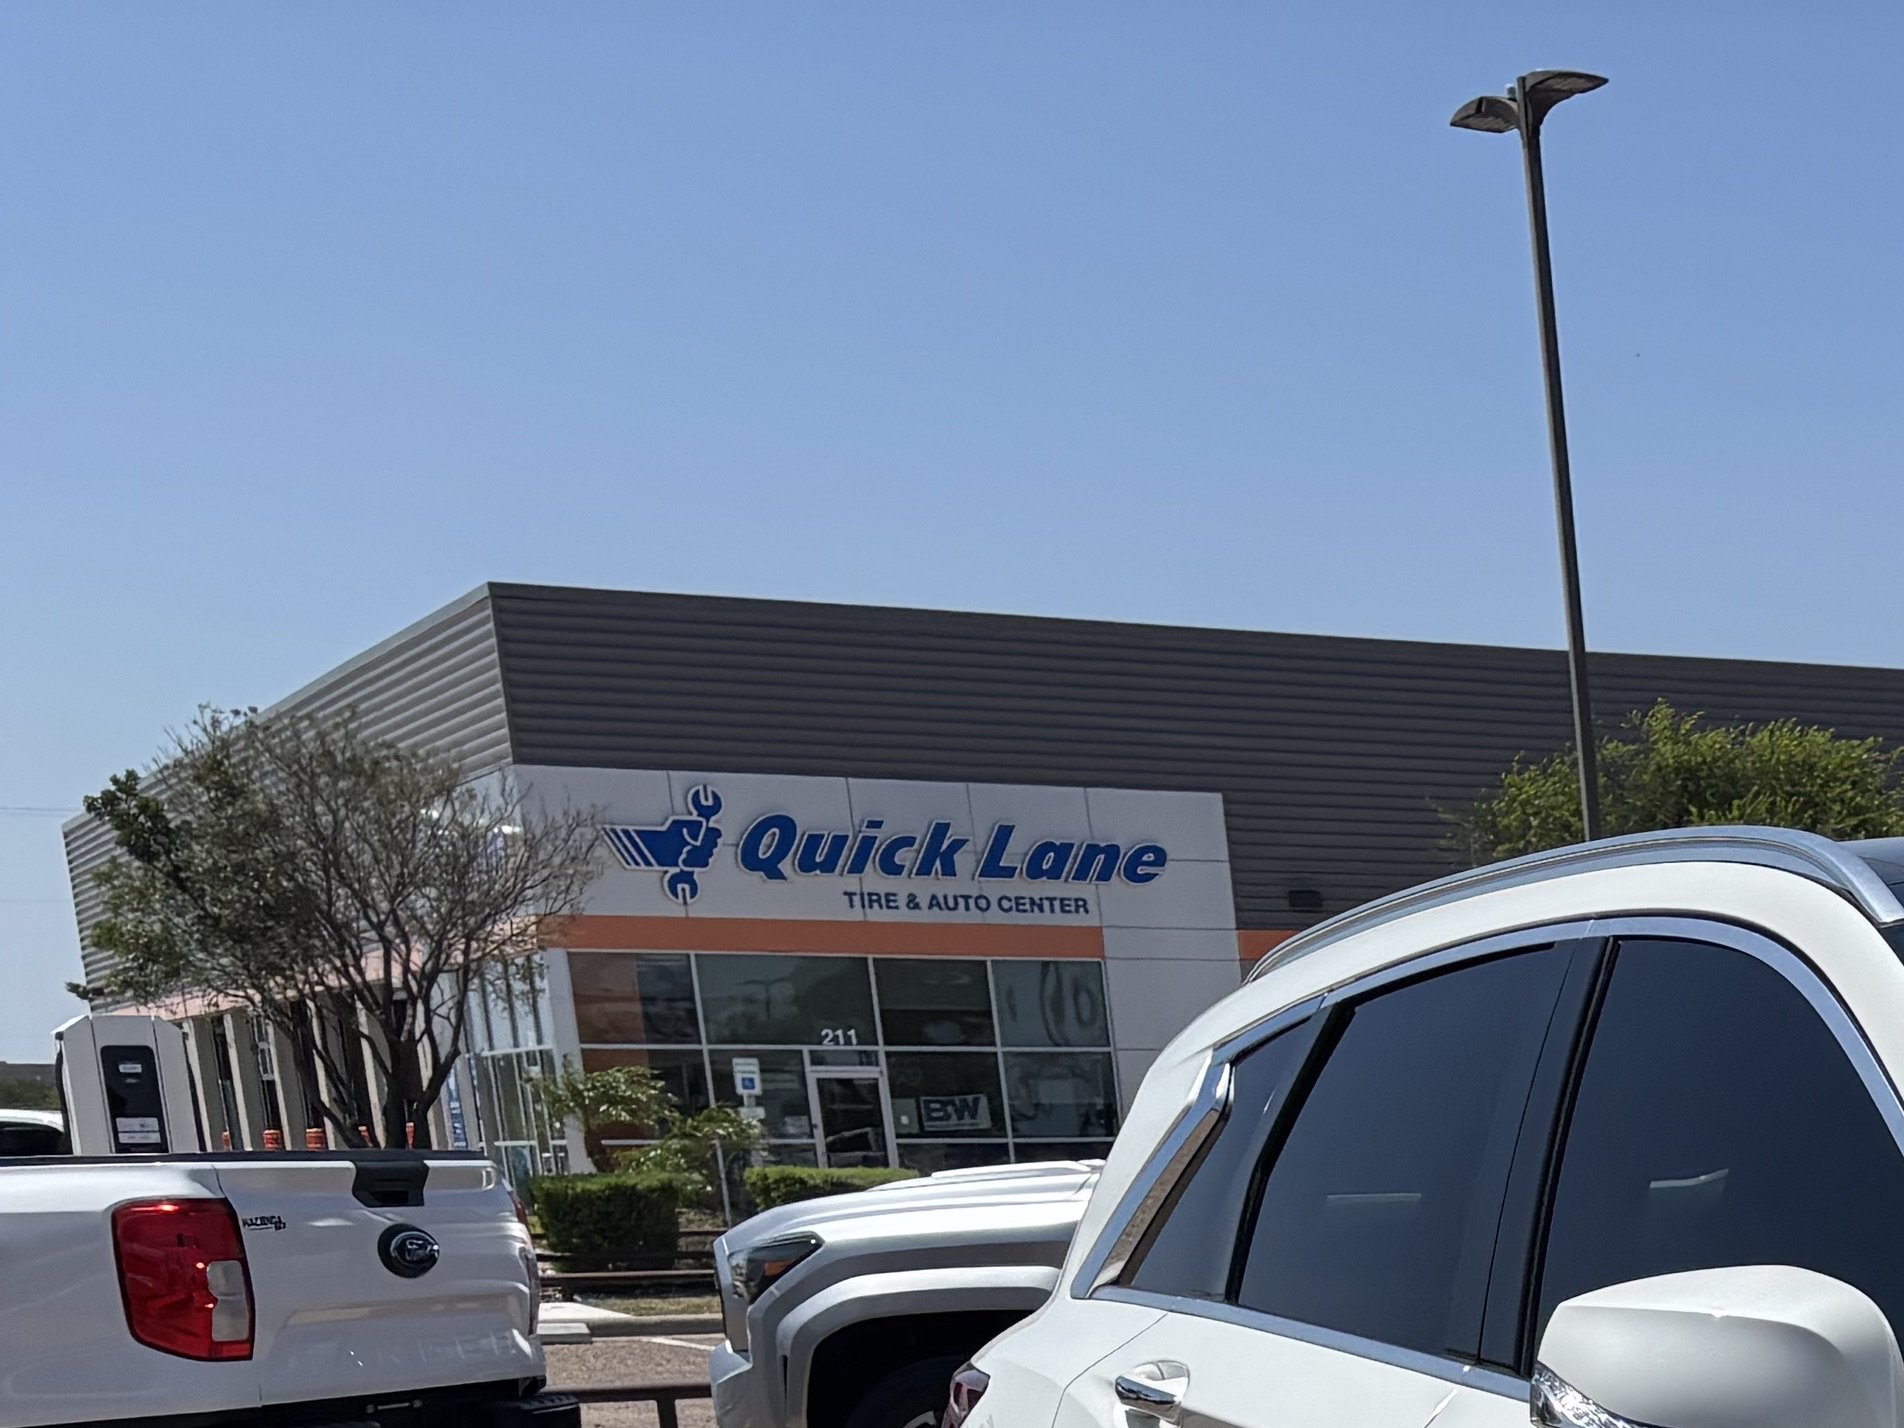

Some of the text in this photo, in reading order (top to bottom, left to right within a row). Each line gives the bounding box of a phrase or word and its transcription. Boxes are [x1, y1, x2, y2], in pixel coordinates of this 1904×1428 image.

[738, 812, 1168, 884] Quick Lane
[843, 890, 1090, 915] TIRE & AUTO CENTER
[820, 1028, 859, 1046] 211
